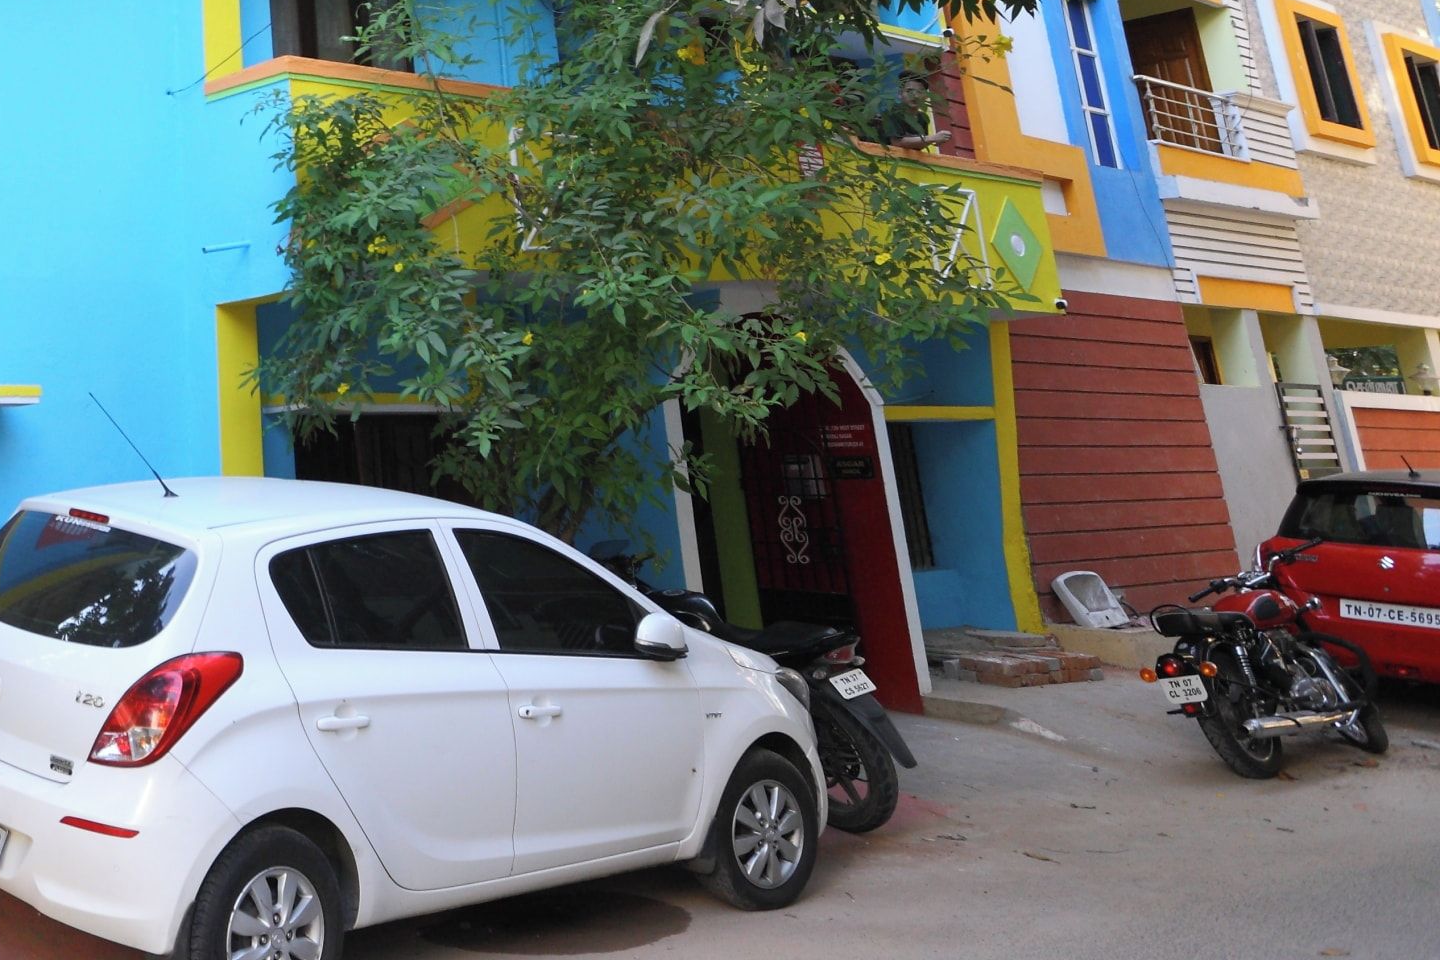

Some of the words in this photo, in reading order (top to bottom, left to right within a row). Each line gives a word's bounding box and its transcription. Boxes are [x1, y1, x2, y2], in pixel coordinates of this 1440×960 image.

[840, 676, 851, 685] TN
[1168, 680, 1181, 688] TN
[1182, 679, 1192, 687] 07
[1169, 690, 1180, 698] CL
